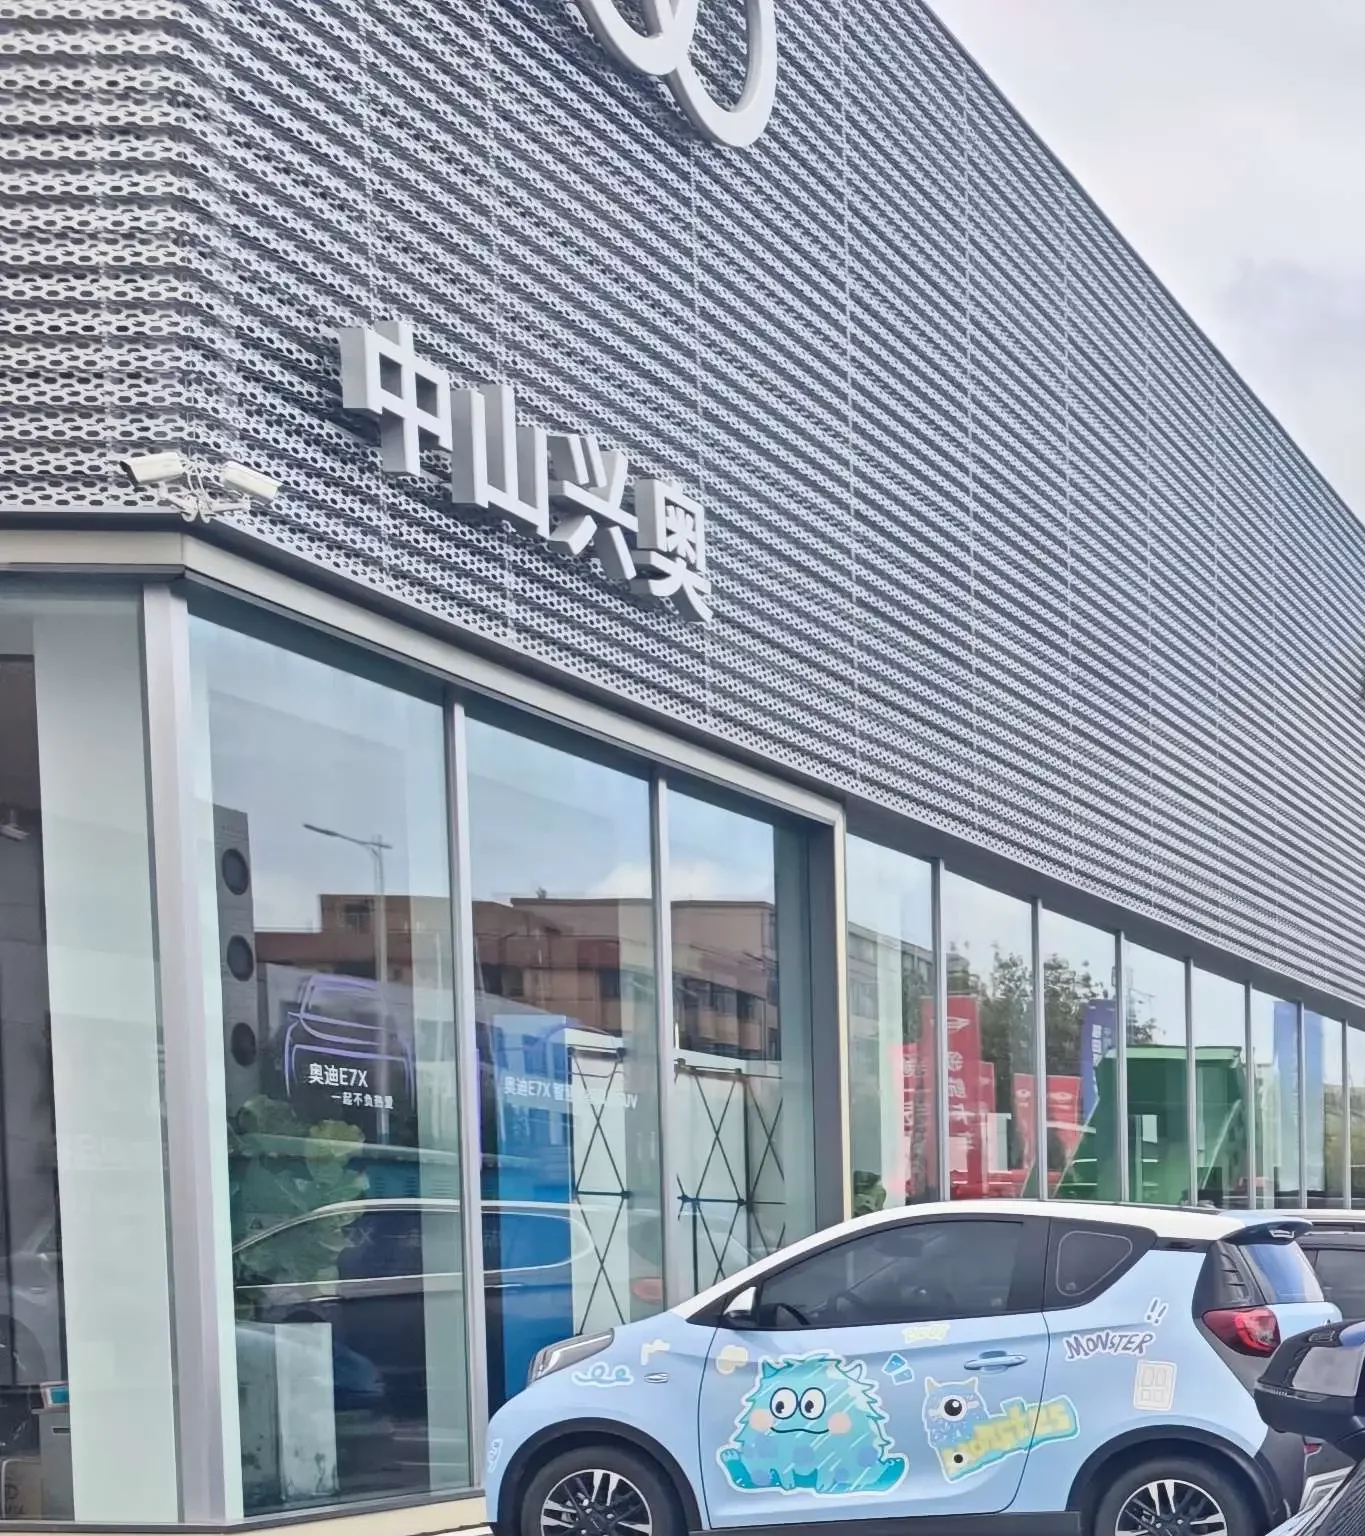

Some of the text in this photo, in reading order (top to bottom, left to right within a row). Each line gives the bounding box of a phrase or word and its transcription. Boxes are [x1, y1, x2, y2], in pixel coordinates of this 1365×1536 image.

[338, 320, 713, 623] 中山兴奥
[308, 1062, 368, 1088] 奥迪E7X
[1065, 1332, 1154, 1361] MONSTER
